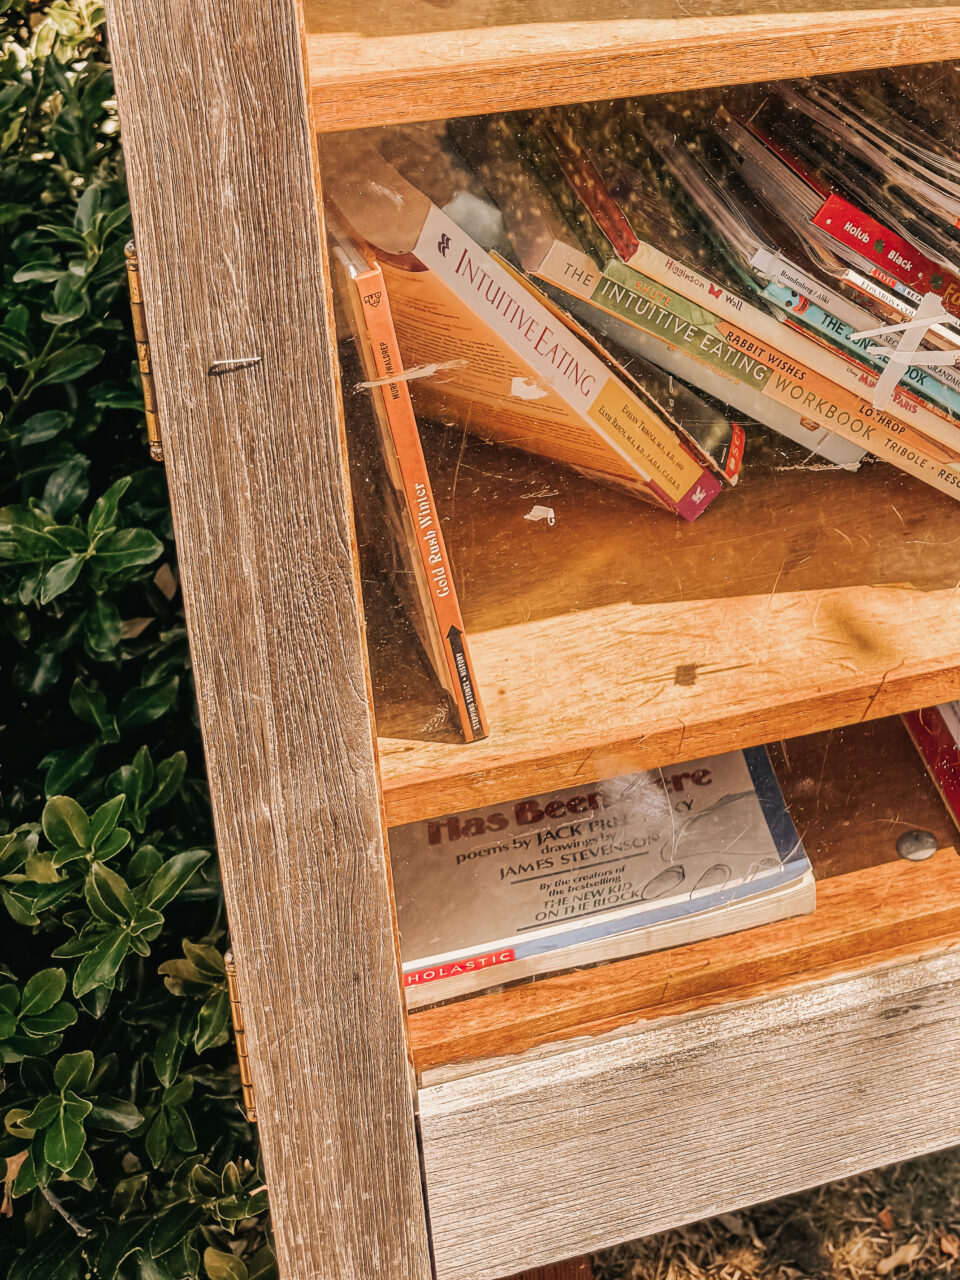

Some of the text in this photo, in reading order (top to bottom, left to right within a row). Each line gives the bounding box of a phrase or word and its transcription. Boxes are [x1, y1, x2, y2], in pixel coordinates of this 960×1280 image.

[843, 220, 914, 271] Holub Black
[780, 270, 813, 295] Brandenberg
[874, 270, 894, 286] LEVEL
[451, 250, 541, 342] INTUITIVE
[531, 327, 599, 397] EATING
[663, 258, 707, 290] Higginson
[723, 294, 744, 311] Wall
[892, 392, 919, 415] PARIS
[819, 312, 846, 335] THE
[562, 262, 593, 287] THE
[603, 280, 695, 342] INTUITIVE
[700, 334, 766, 381] EATING
[775, 375, 874, 441] WORKBOOK
[884, 438, 927, 468] TRIBOLE
[725, 330, 765, 359] RABBIT
[766, 352, 806, 381] WISHES
[597, 405, 614, 422] ELYSE
[620, 404, 640, 425] EVELYN
[412, 482, 450, 597] Gold Rush Winter
[455, 652, 480, 729] STEPPING STONES HISTORY
[427, 813, 509, 846] Has
[455, 823, 583, 865] poems by JACK
[540, 834, 599, 855] drawings
[499, 833, 660, 881] JAMES STEVENSON
[567, 875, 621, 893] bestselling
[573, 870, 614, 883] creators
[543, 881, 633, 910] THE NEW KID
[535, 902, 590, 922] ON THE
